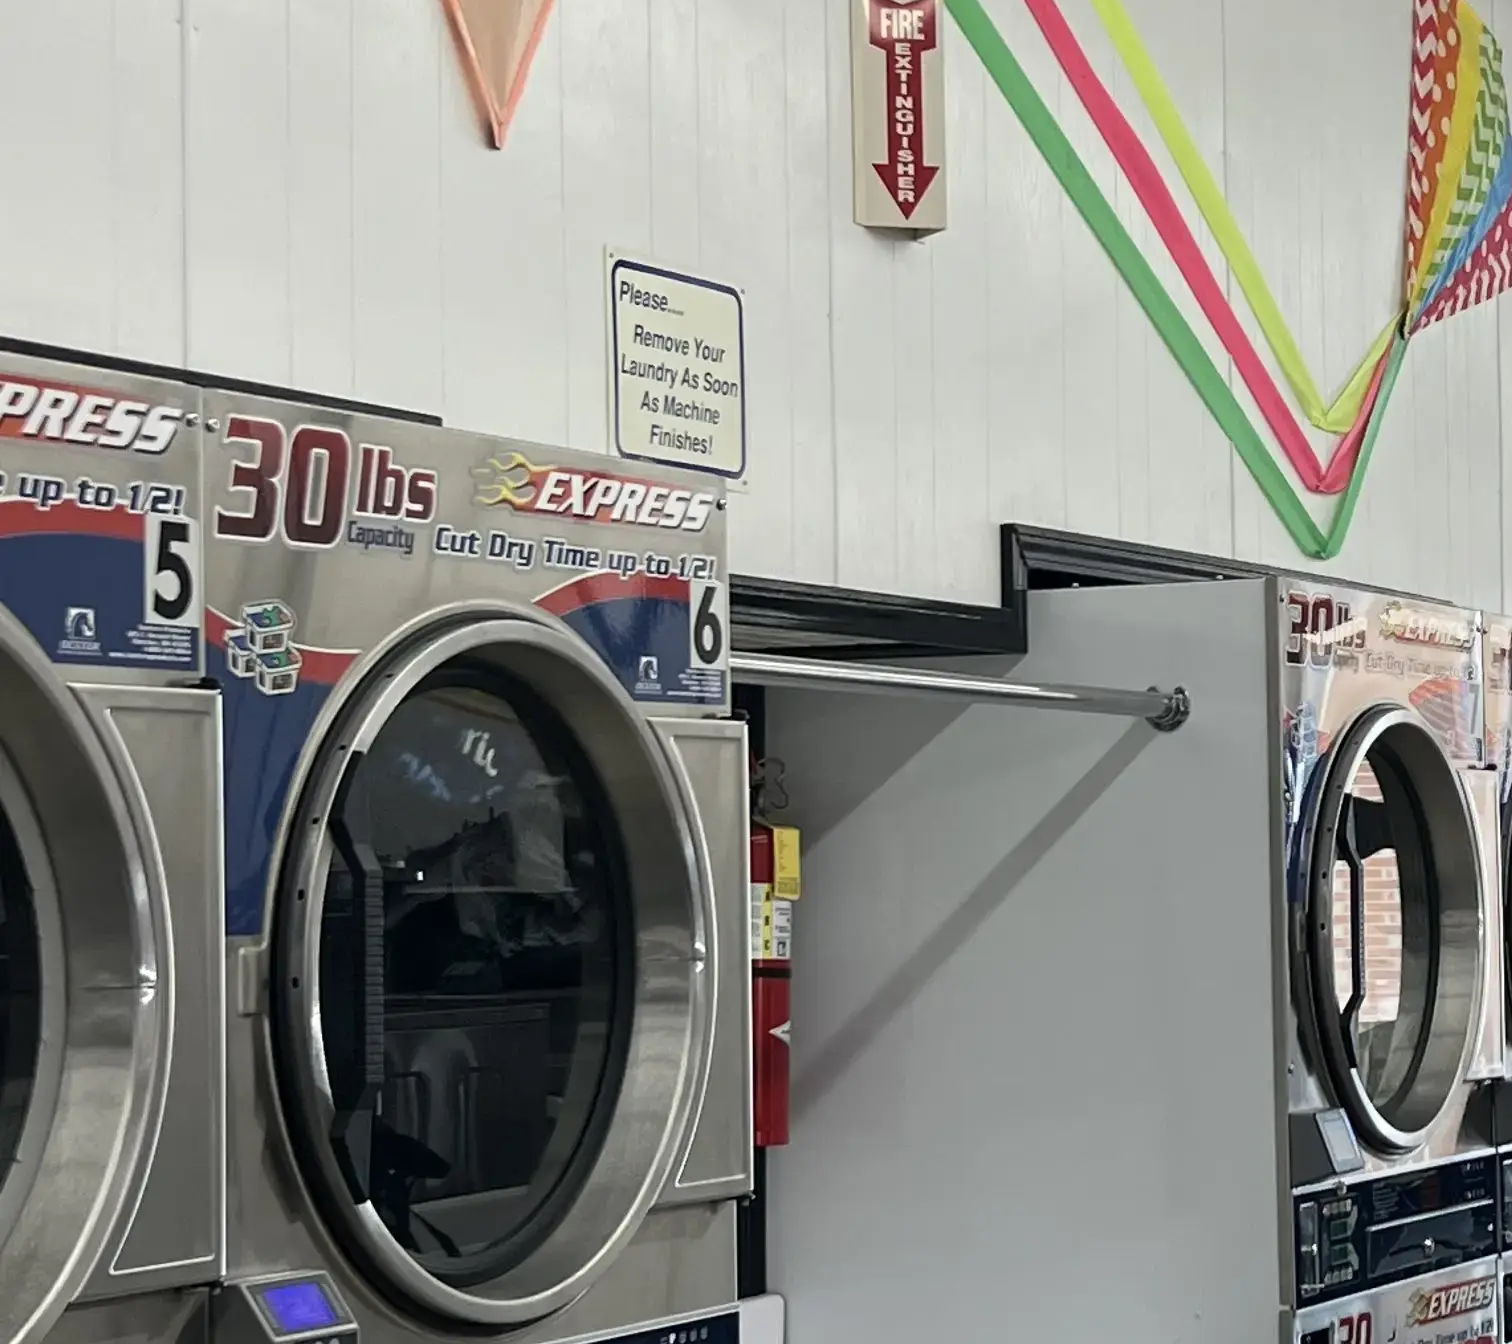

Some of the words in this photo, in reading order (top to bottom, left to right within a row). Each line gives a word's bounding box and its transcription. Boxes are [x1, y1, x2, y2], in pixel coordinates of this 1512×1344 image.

[880, 8, 925, 40] FIRE
[895, 42, 916, 203] EXTINGUISHER
[633, 324, 690, 356] Remove
[694, 337, 726, 363] Your
[621, 353, 678, 389] Laundry
[681, 367, 700, 390] As
[703, 372, 738, 397] Soon
[640, 391, 660, 413] As
[663, 395, 721, 425] Machine
[650, 424, 713, 455] Finishes!
[19, 476, 64, 508] up
[78, 479, 116, 507] to
[128, 484, 185, 515] 1/2!
[215, 414, 351, 548] 30
[355, 444, 437, 523] lbs
[535, 472, 714, 532] EXPRESS
[347, 520, 414, 554] Capacity
[435, 527, 480, 555] Cut
[489, 532, 533, 567] Dry
[544, 539, 599, 569] Time
[608, 554, 637, 577] up
[646, 555, 670, 576] to
[153, 520, 192, 621] 5
[694, 585, 722, 665] 6
[1428, 1280, 1495, 1321] EXPRESS
